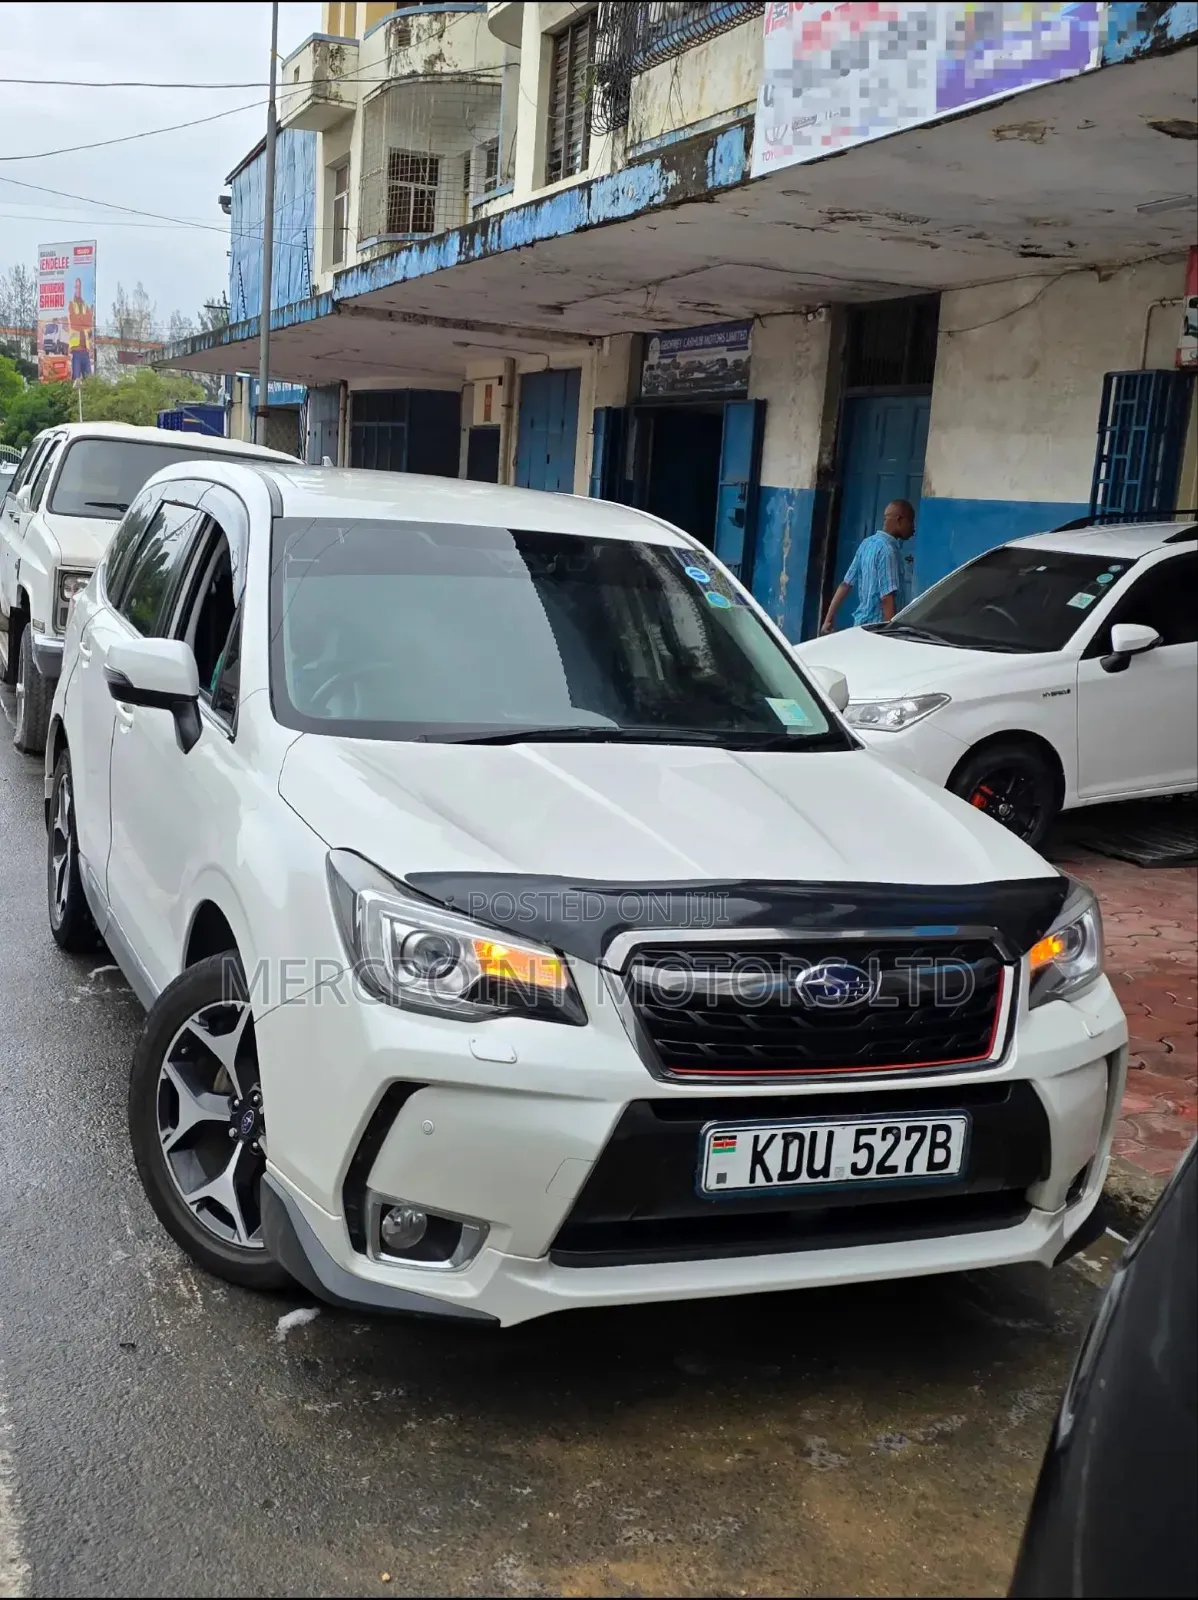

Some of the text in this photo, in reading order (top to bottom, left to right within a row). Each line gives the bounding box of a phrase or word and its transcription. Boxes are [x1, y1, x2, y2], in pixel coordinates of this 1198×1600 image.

[704, 333, 726, 345] MOTORS
[726, 330, 747, 342] LIMITED
[749, 1123, 952, 1184] KDU 527B
